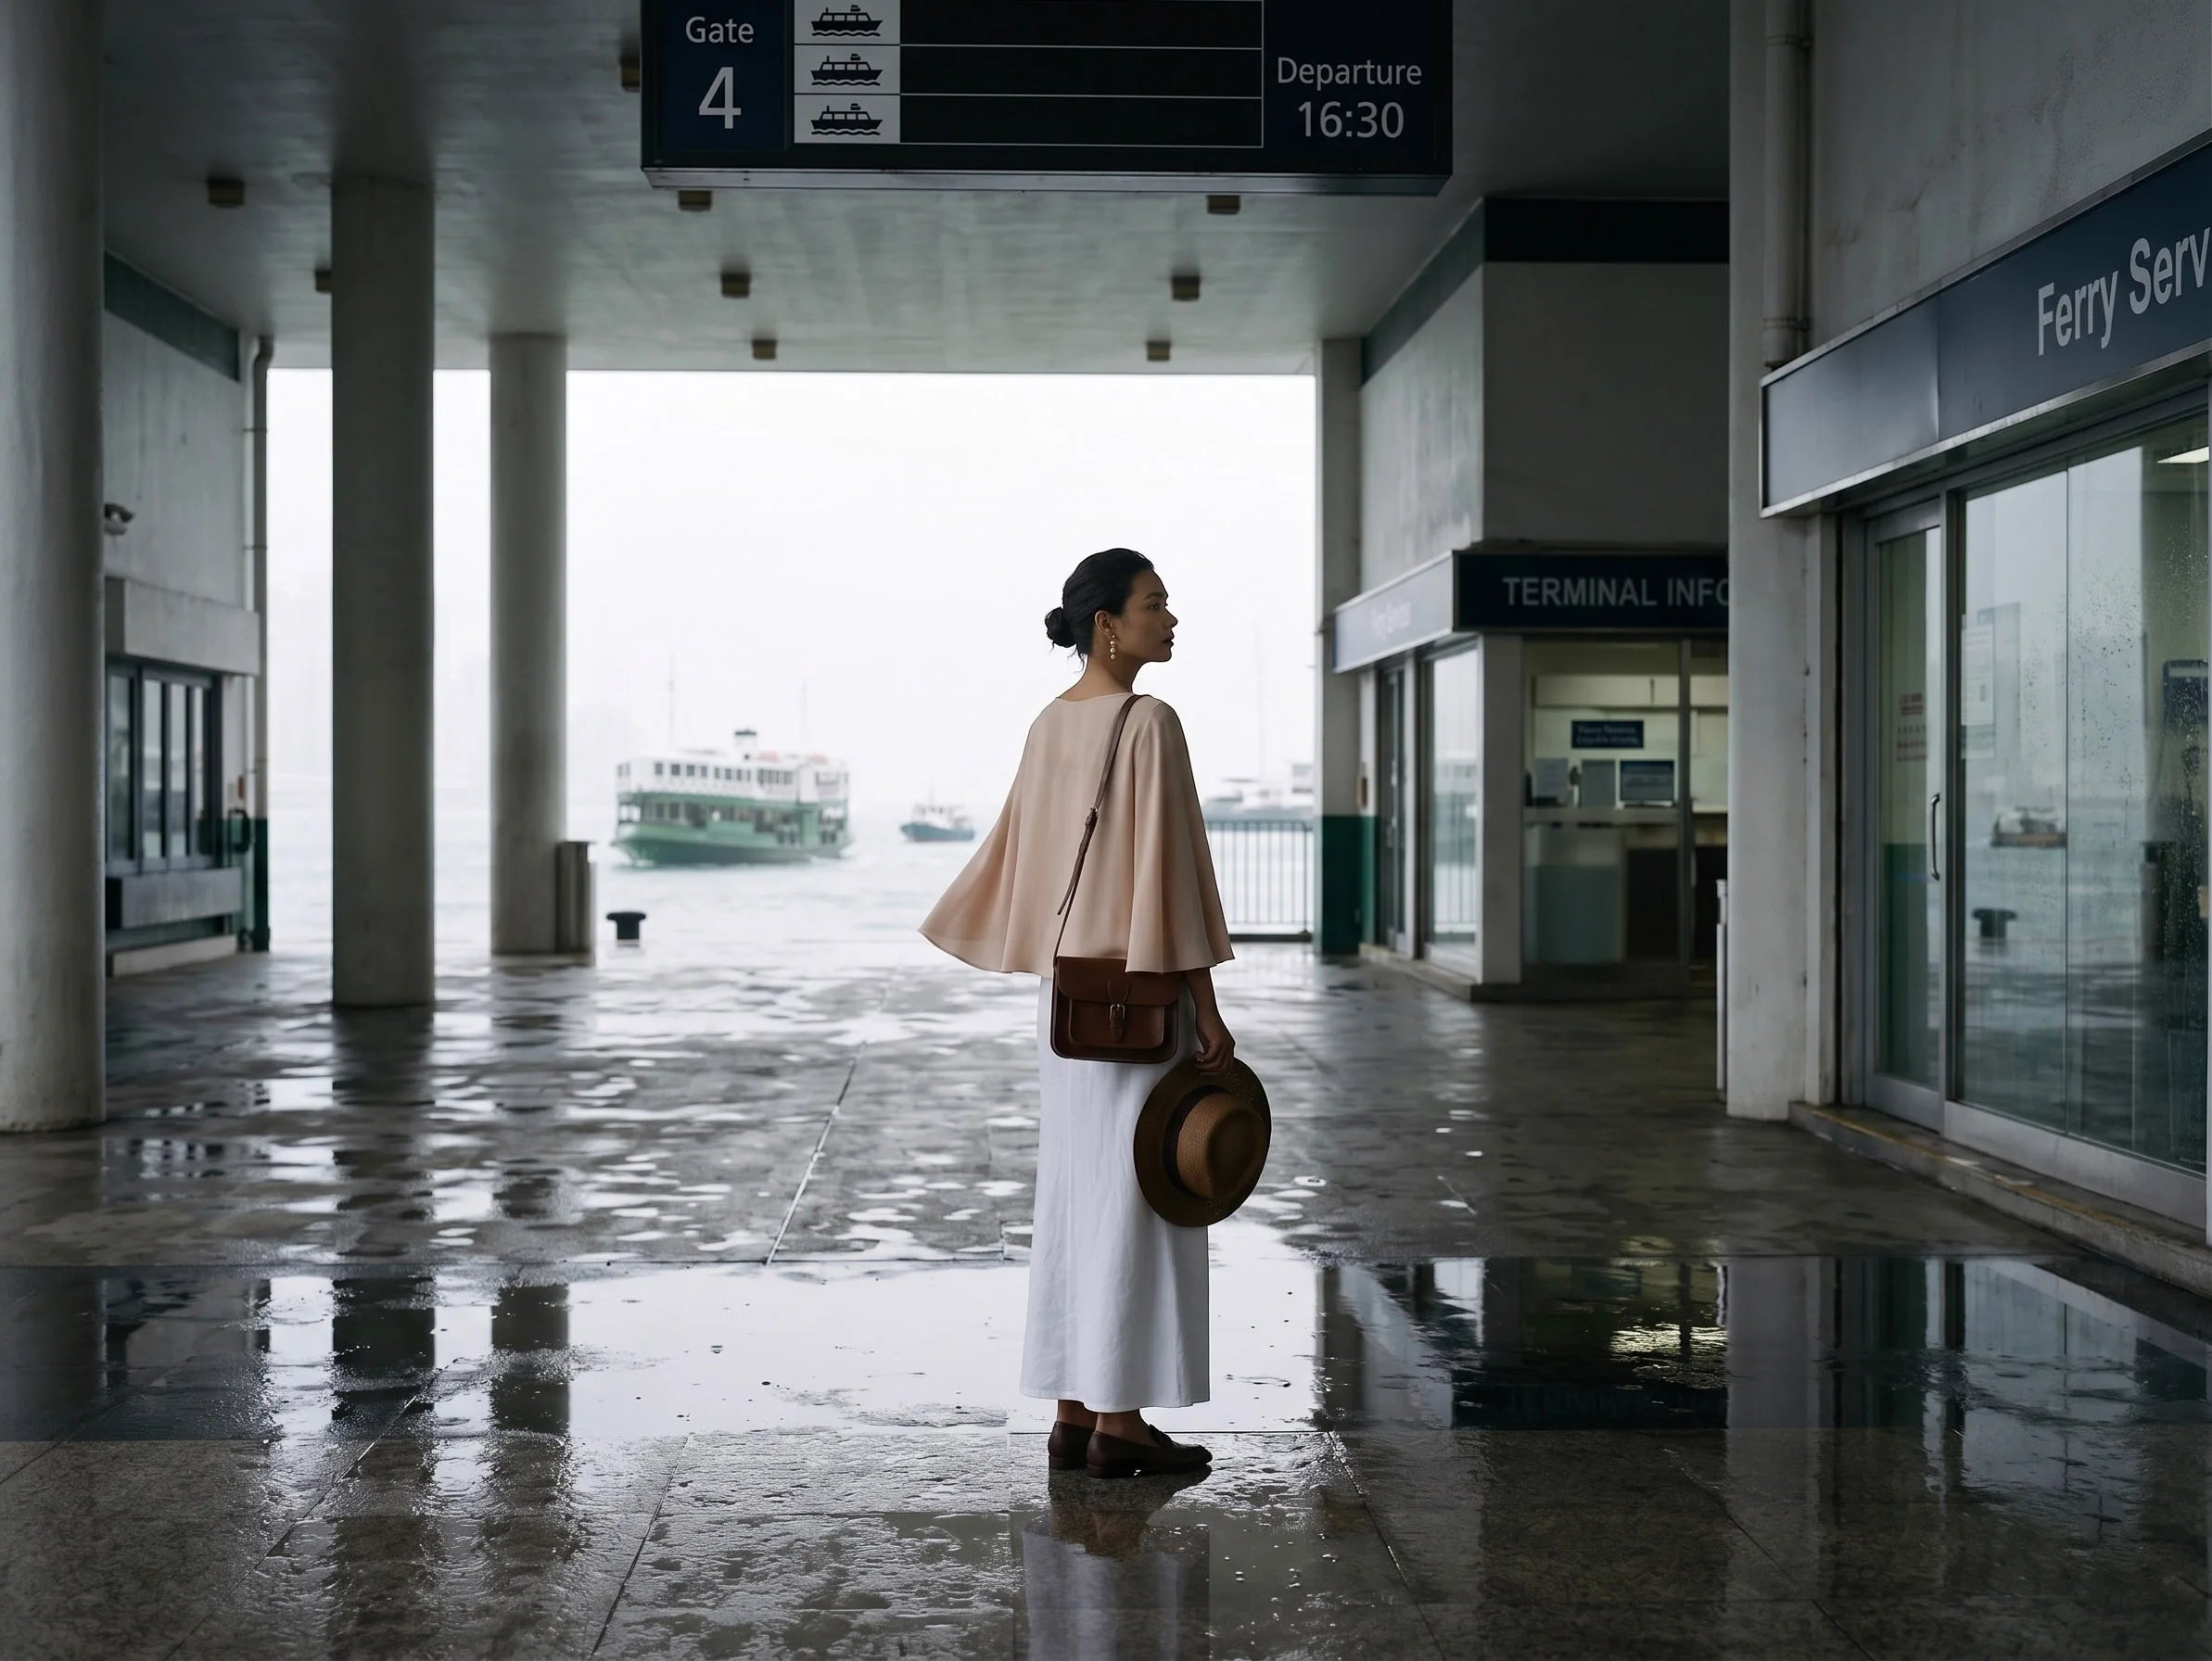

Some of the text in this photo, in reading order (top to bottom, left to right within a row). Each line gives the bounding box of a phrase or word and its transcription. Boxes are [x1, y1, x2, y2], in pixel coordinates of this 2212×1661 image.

[686, 17, 755, 44] Gate
[1278, 57, 1422, 91] Departure
[698, 66, 742, 130] 4
[1298, 100, 1405, 138] 16:30
[2038, 226, 2212, 357] Ferry Serv
[1502, 577, 1658, 607] TERMINAL
